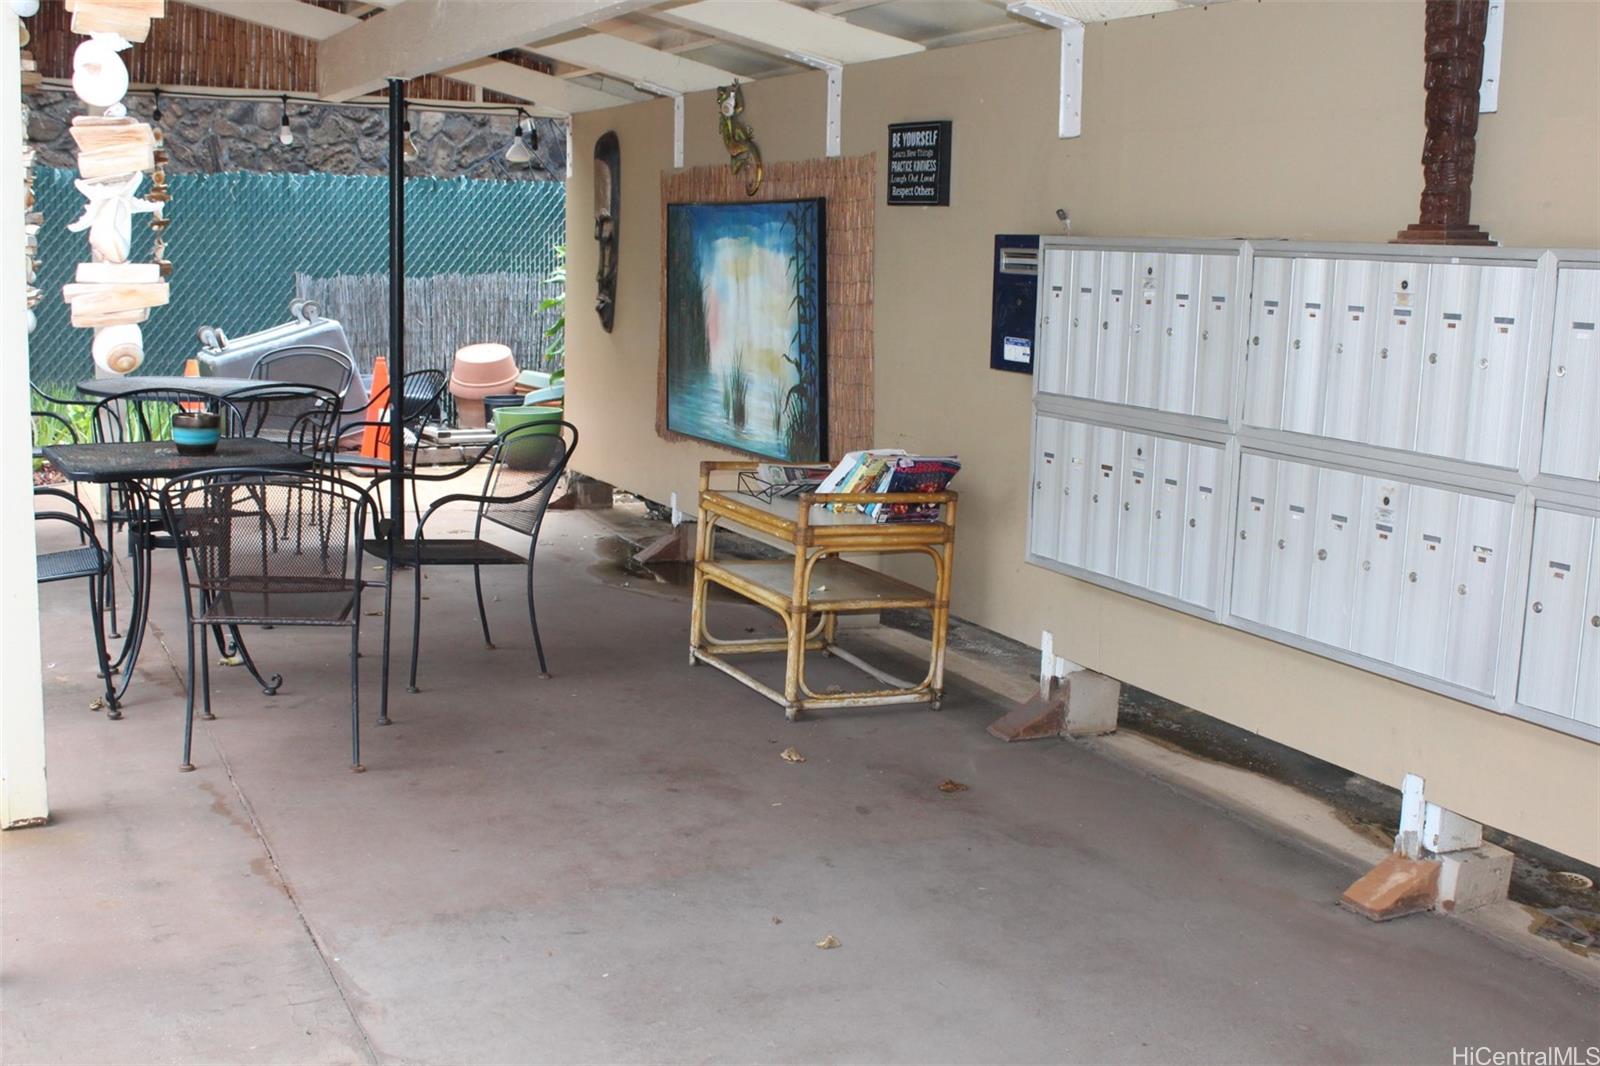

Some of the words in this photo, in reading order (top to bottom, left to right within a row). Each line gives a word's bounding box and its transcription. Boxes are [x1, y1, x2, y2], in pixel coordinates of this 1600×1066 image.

[892, 133, 901, 147] BE
[902, 130, 937, 147] YOURSELF
[891, 160, 913, 172] PRACTICE
[914, 160, 936, 172] KINDNESS
[908, 173, 919, 182] Out
[892, 186, 914, 198] Respect
[914, 185, 935, 196] Others
